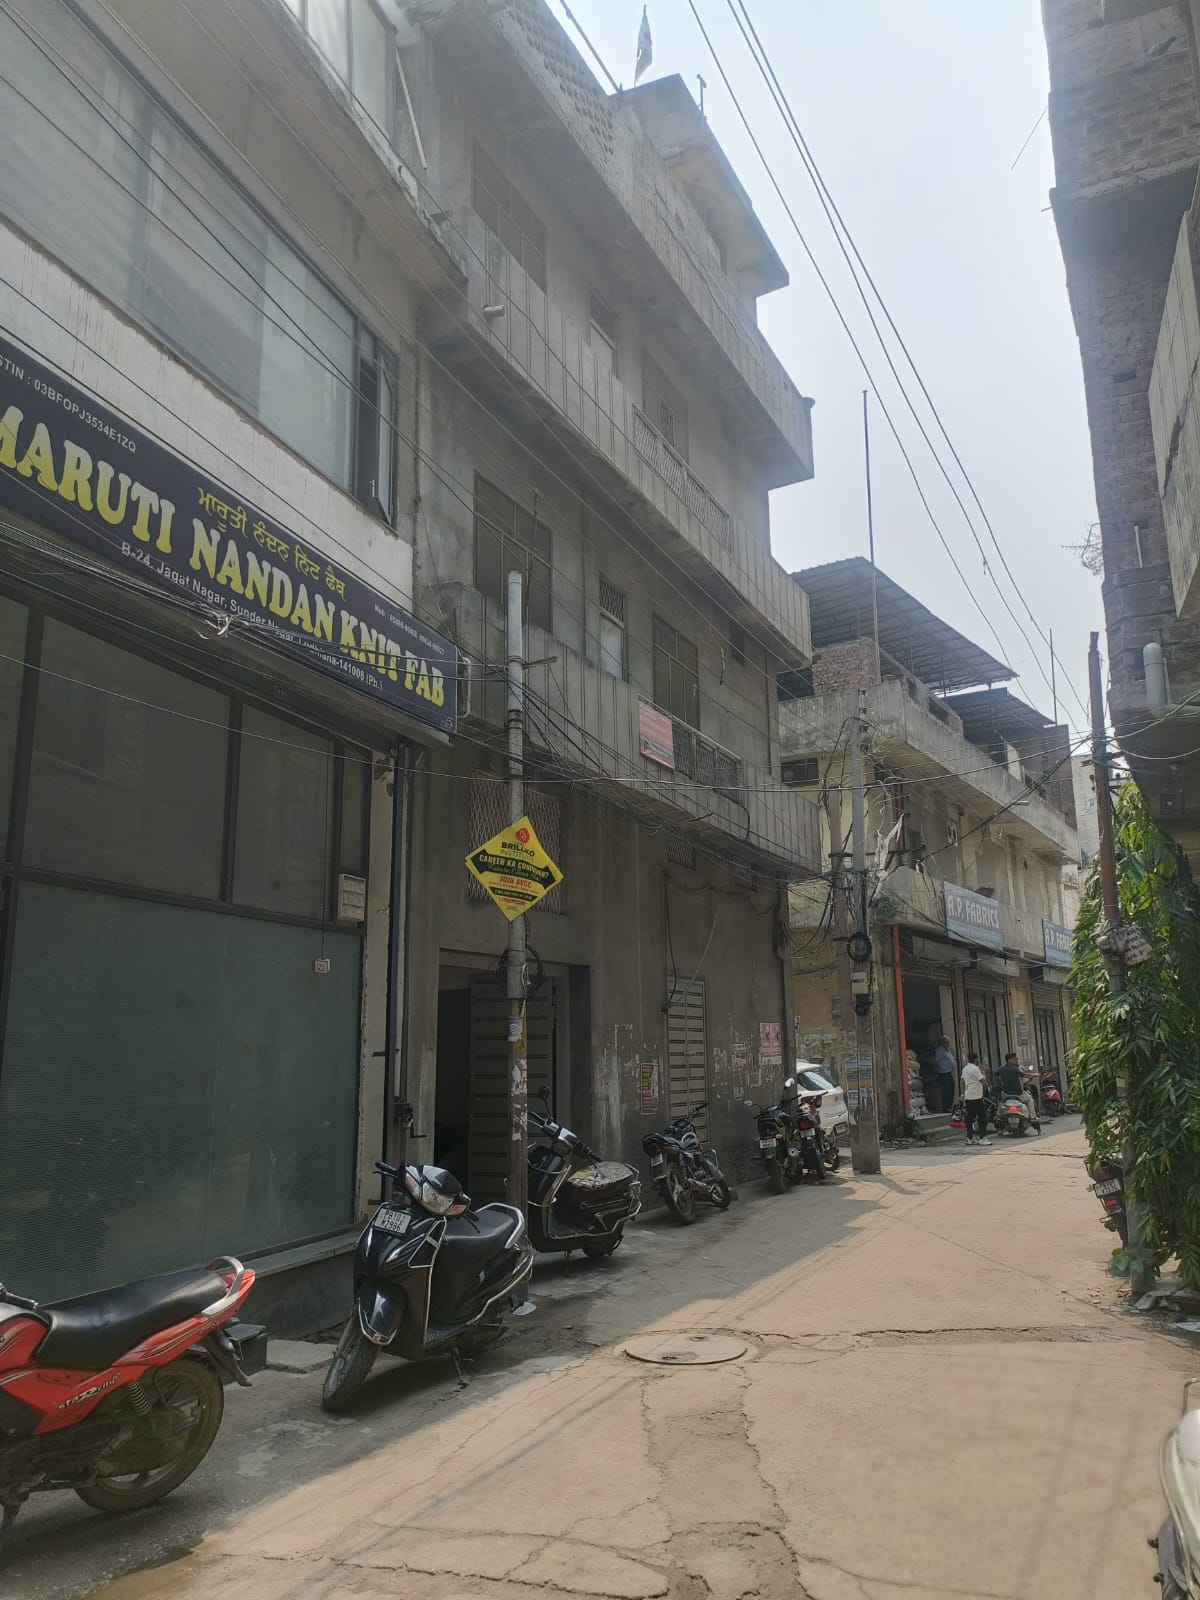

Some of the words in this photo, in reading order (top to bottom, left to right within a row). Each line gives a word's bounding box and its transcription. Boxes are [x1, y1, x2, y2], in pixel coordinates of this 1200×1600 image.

[34, 378, 137, 454] 03BFOPJ3534E1ZQ
[157, 561, 190, 587] Jagat
[192, 578, 227, 608] Nagar,
[189, 518, 336, 642] NANDAN
[340, 609, 402, 681] KNIT
[404, 650, 445, 706] FAB
[965, 900, 1000, 929] FABRICS
